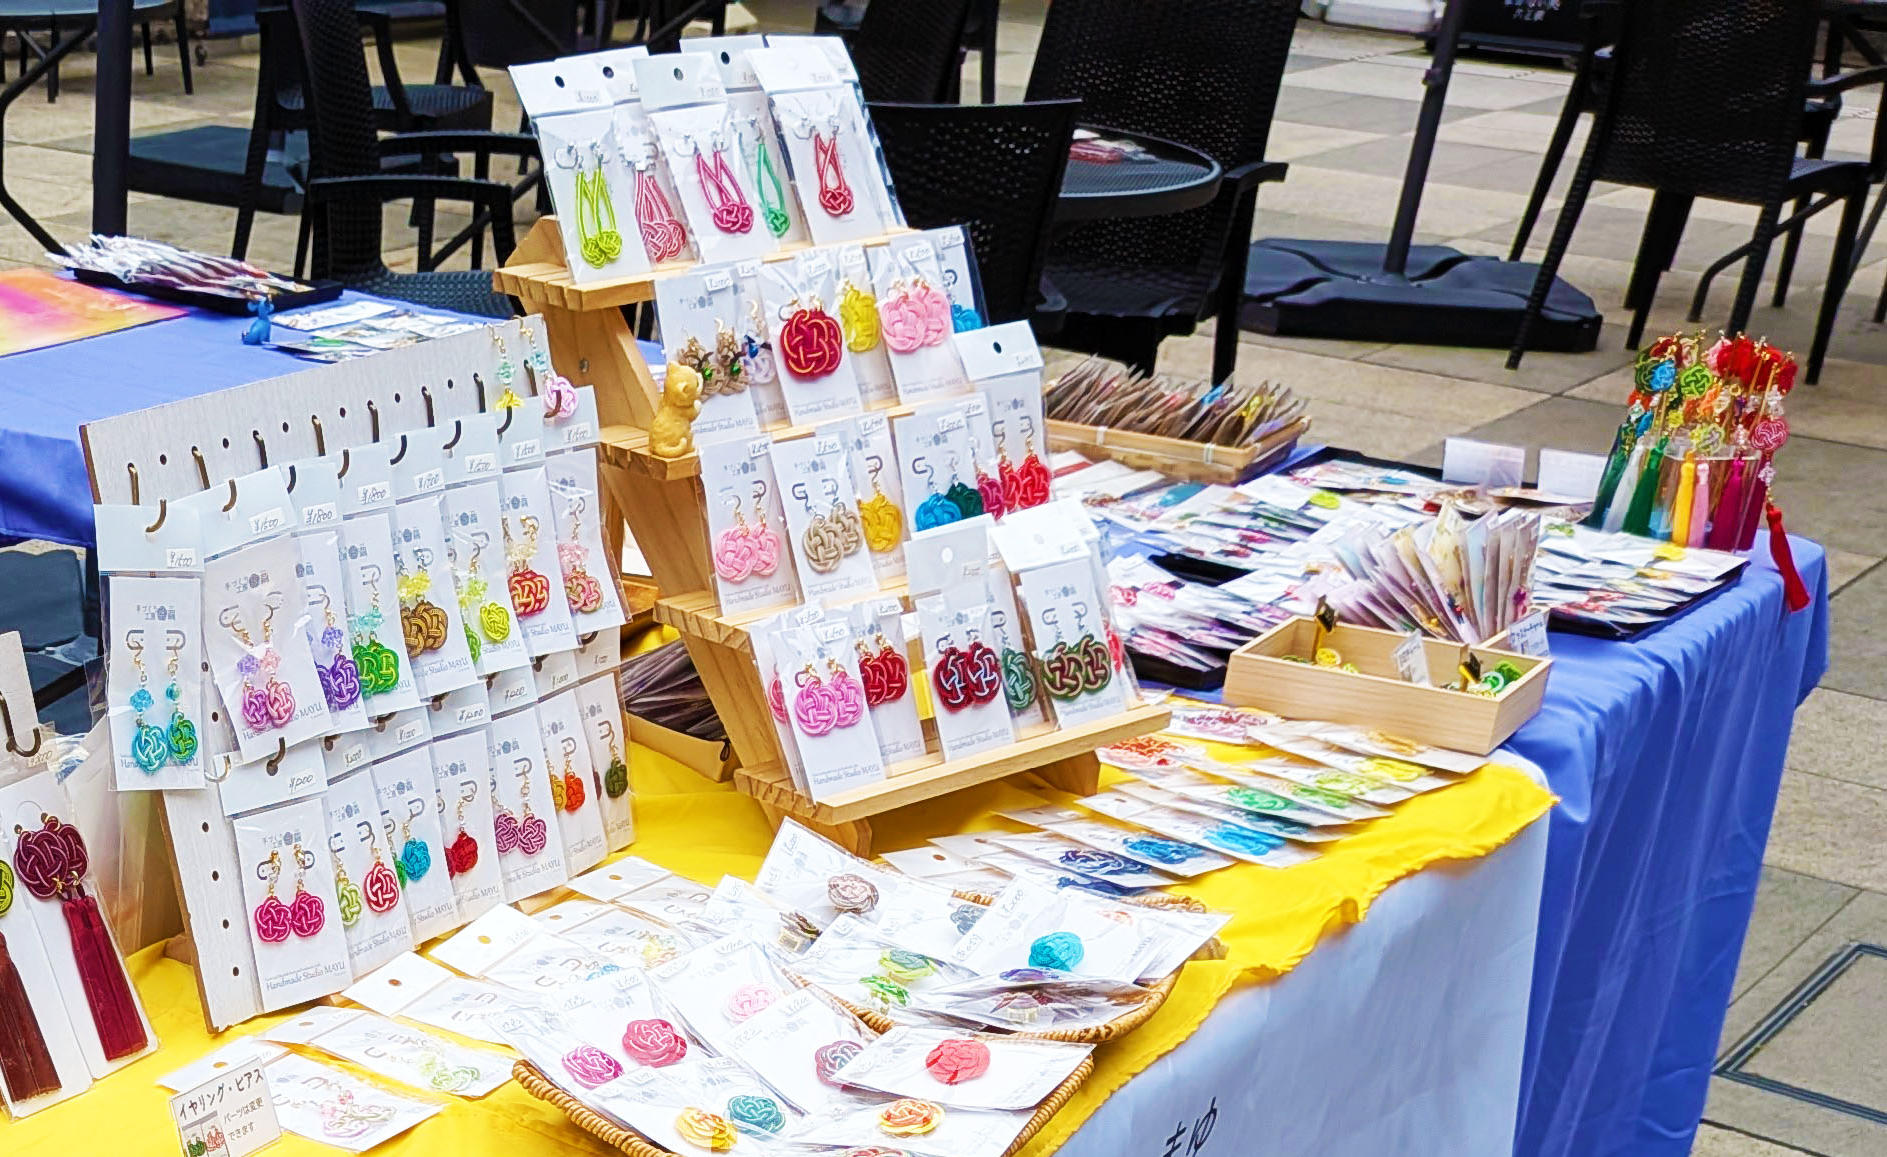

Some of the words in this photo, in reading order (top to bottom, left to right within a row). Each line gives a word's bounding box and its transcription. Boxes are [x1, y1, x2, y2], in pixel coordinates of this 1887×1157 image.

[266, 974, 301, 991] Handmade
[303, 969, 323, 981] Studio
[324, 962, 345, 974] MAYU
[180, 1069, 263, 1120] イヤリング・ピアス
[224, 1097, 264, 1123] パーツは変更
[228, 1122, 254, 1141] できます
